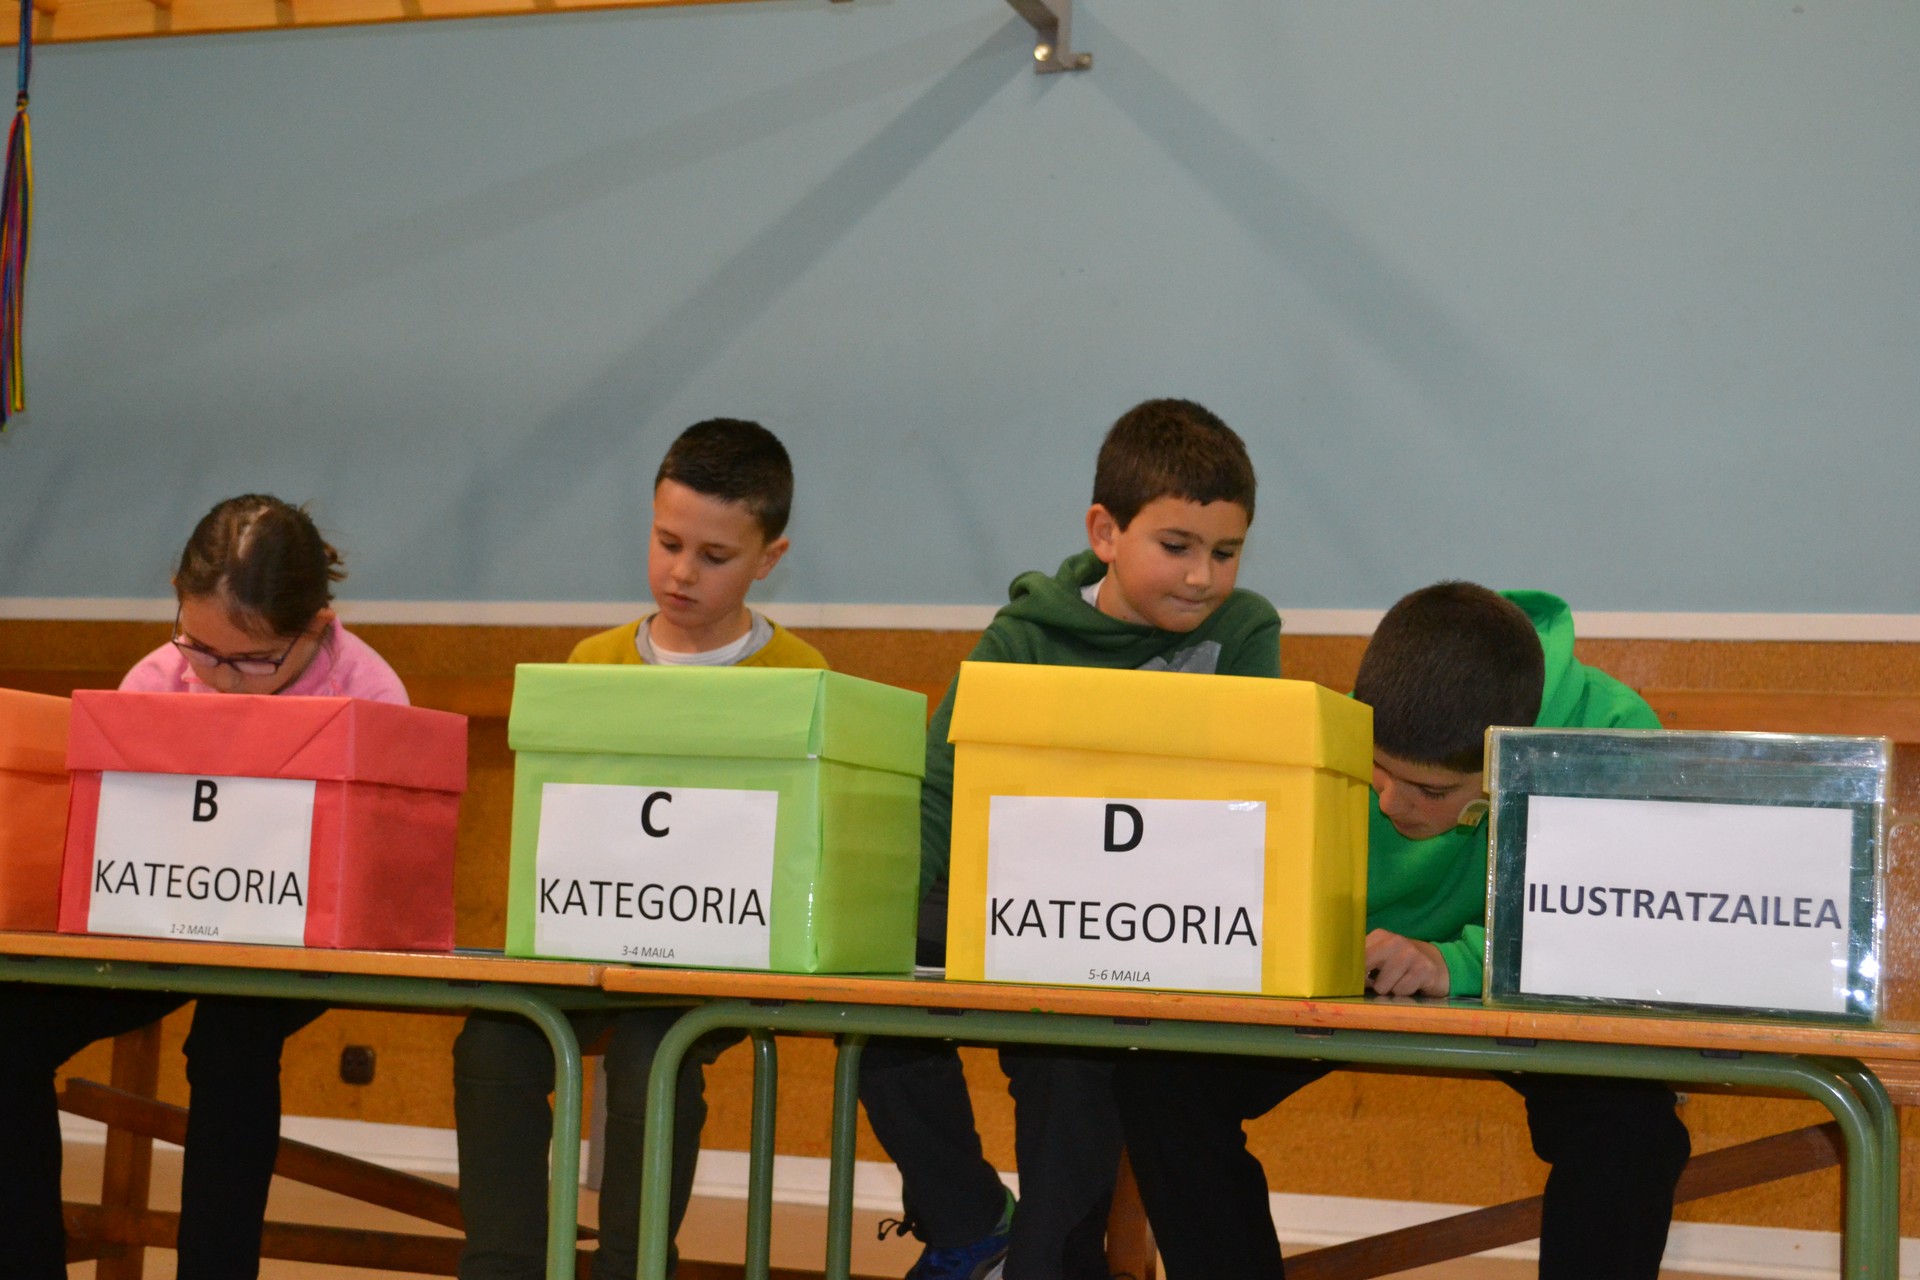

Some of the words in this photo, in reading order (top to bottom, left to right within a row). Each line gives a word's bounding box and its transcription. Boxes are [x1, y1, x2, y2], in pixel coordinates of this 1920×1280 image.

[192, 779, 218, 822] B
[641, 791, 672, 837] C
[1104, 804, 1143, 852] D
[95, 859, 303, 906] KATEGORIA
[541, 878, 765, 926] KATEGORIA
[992, 898, 1257, 946] KATEGORIA
[1529, 884, 1841, 929] ILUSTRATZAILEA
[170, 923, 186, 934] 1-2
[187, 924, 219, 936] MAILA
[621, 945, 639, 956] 3-4
[641, 946, 675, 959] MAILA
[1088, 968, 1108, 981] 5-6
[1111, 969, 1151, 982] MAILA
